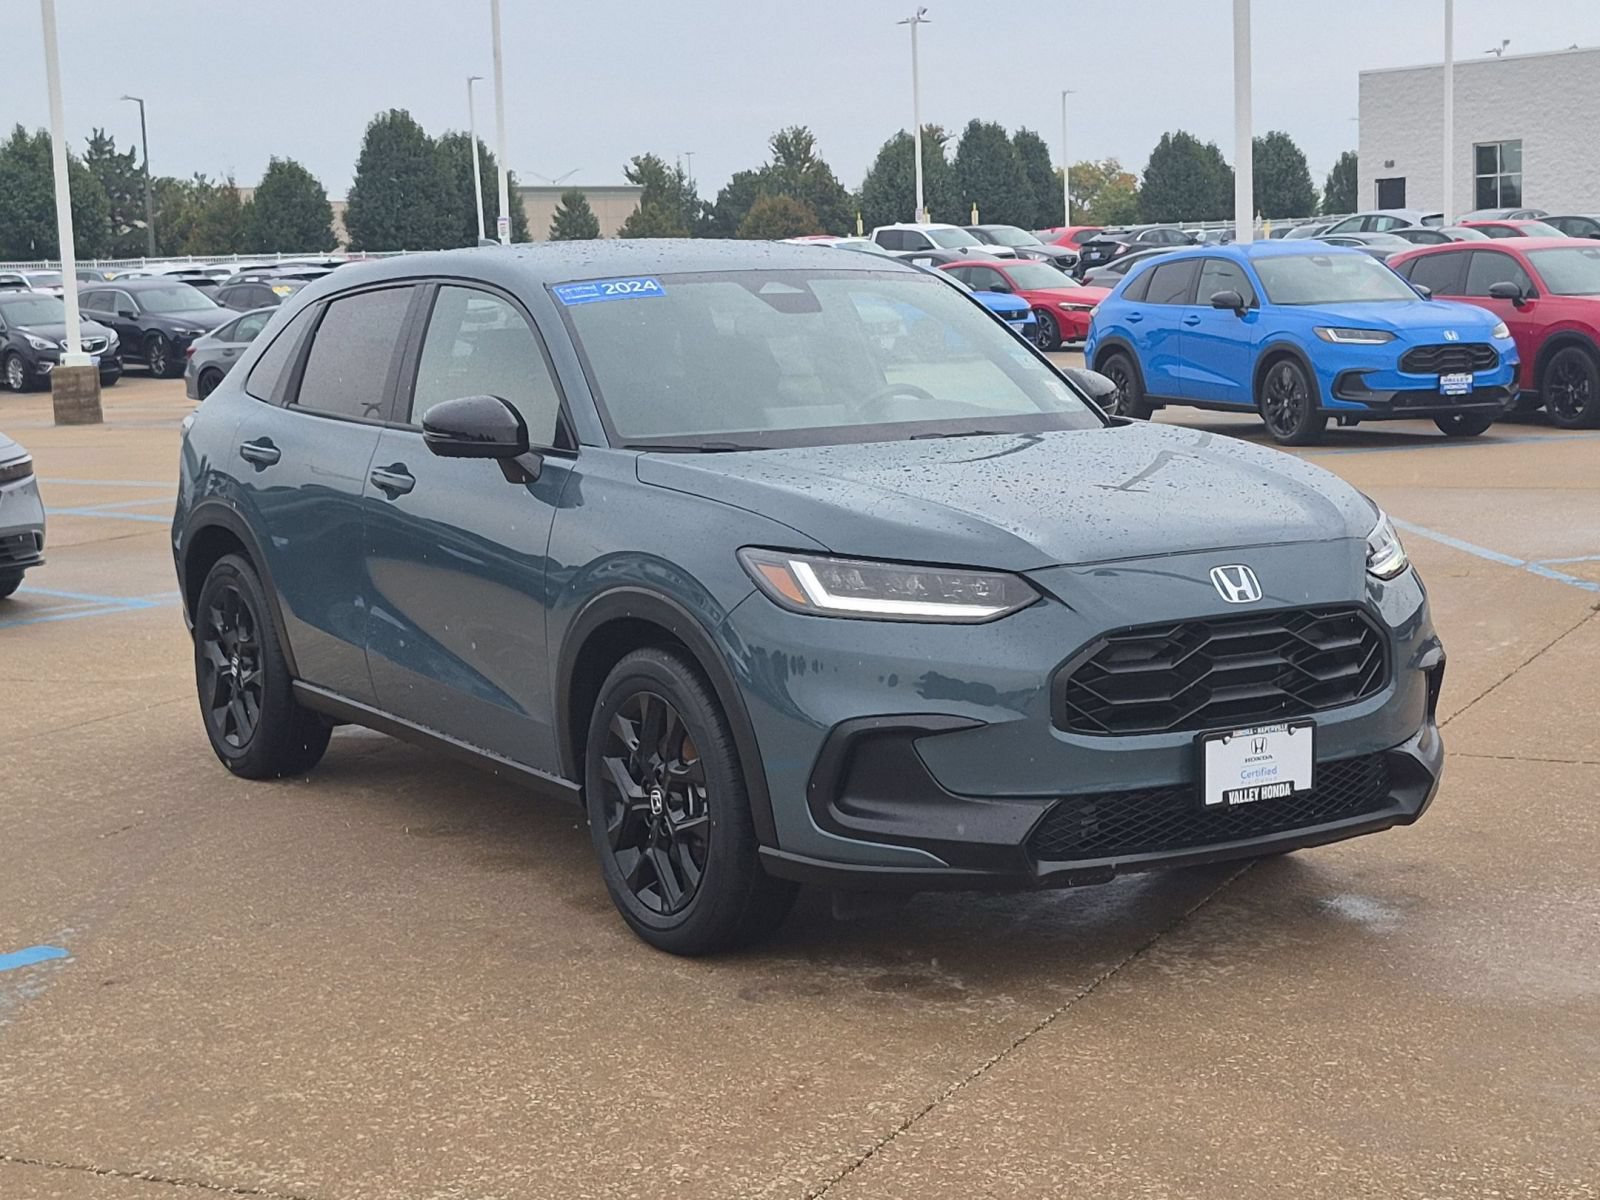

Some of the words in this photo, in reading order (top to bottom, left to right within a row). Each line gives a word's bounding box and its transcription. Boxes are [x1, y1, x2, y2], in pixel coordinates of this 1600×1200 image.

[601, 280, 658, 295] 2024
[1245, 754, 1273, 763] HONDA
[1240, 765, 1278, 779] Certified
[1228, 787, 1260, 805] VALLEY
[1261, 782, 1291, 800] HONDA
